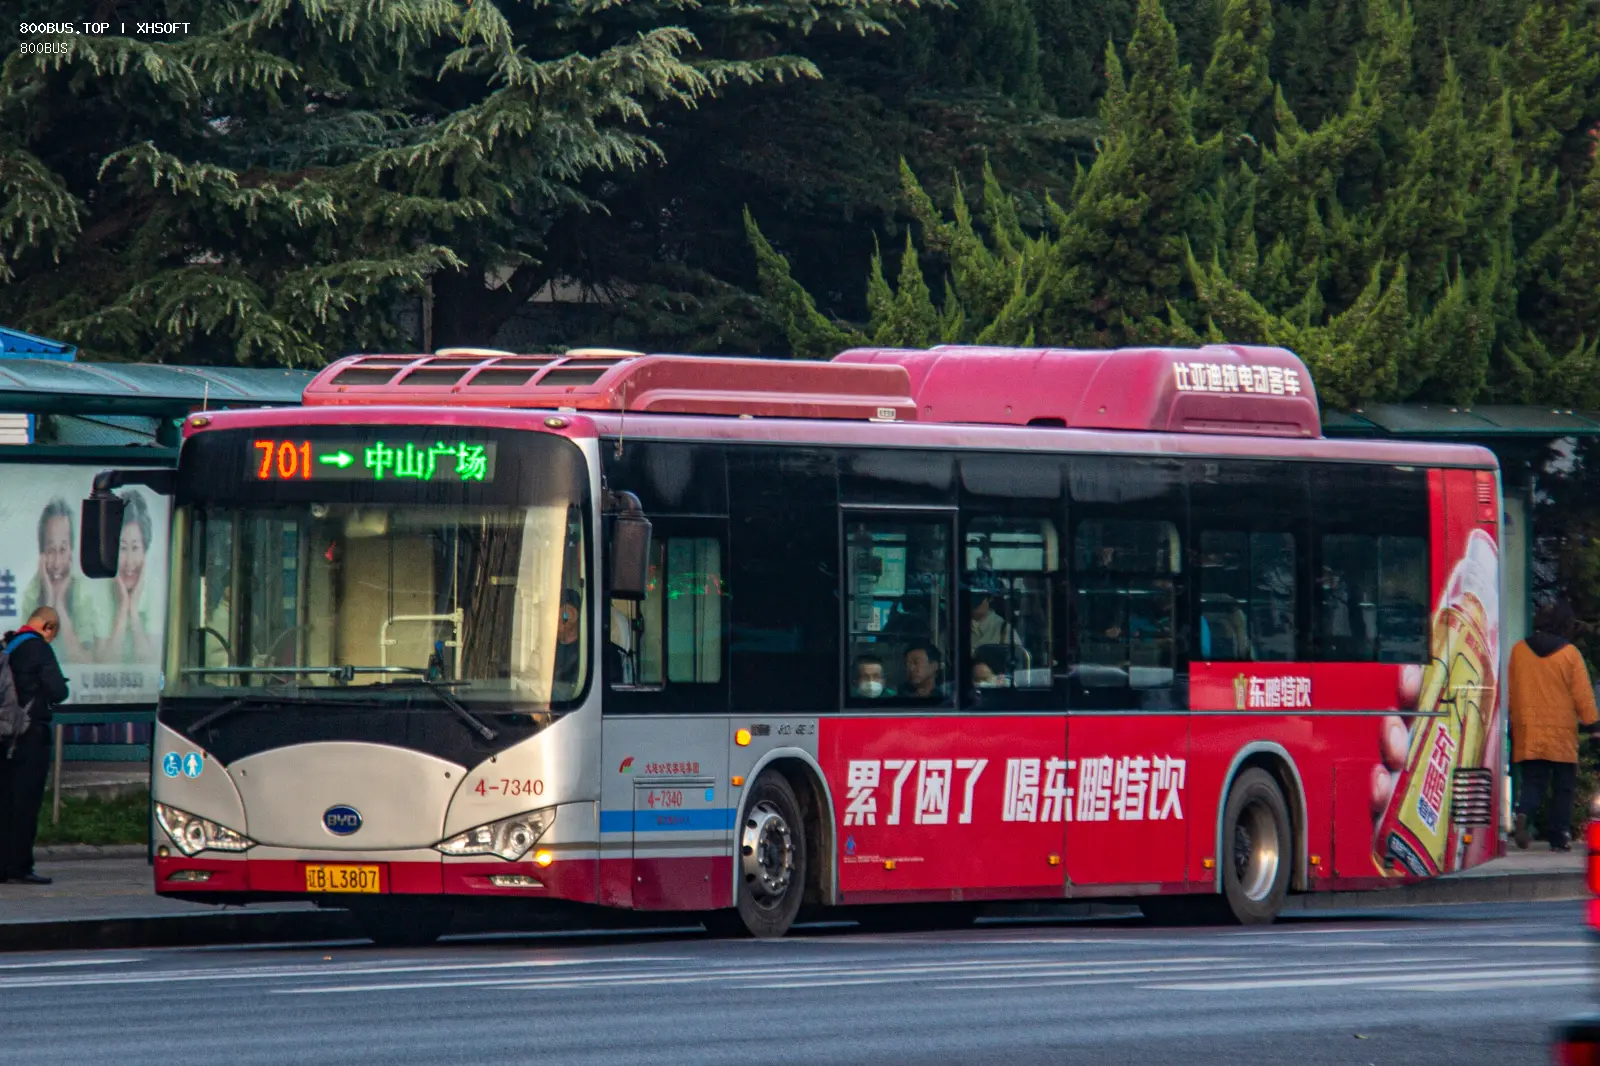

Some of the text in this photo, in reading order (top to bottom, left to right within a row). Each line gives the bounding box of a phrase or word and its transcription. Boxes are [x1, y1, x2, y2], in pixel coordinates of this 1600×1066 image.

[1173, 361, 1300, 396] 比亚迪纯电动客车
[254, 440, 488, 481] 701 中山广场
[1249, 675, 1312, 708] 东鹏特饮
[475, 778, 544, 797] 4-7340
[648, 790, 683, 808] 4-7340
[843, 752, 1187, 827] 累了困了 喝东鹏特饮
[327, 814, 358, 826] BYD
